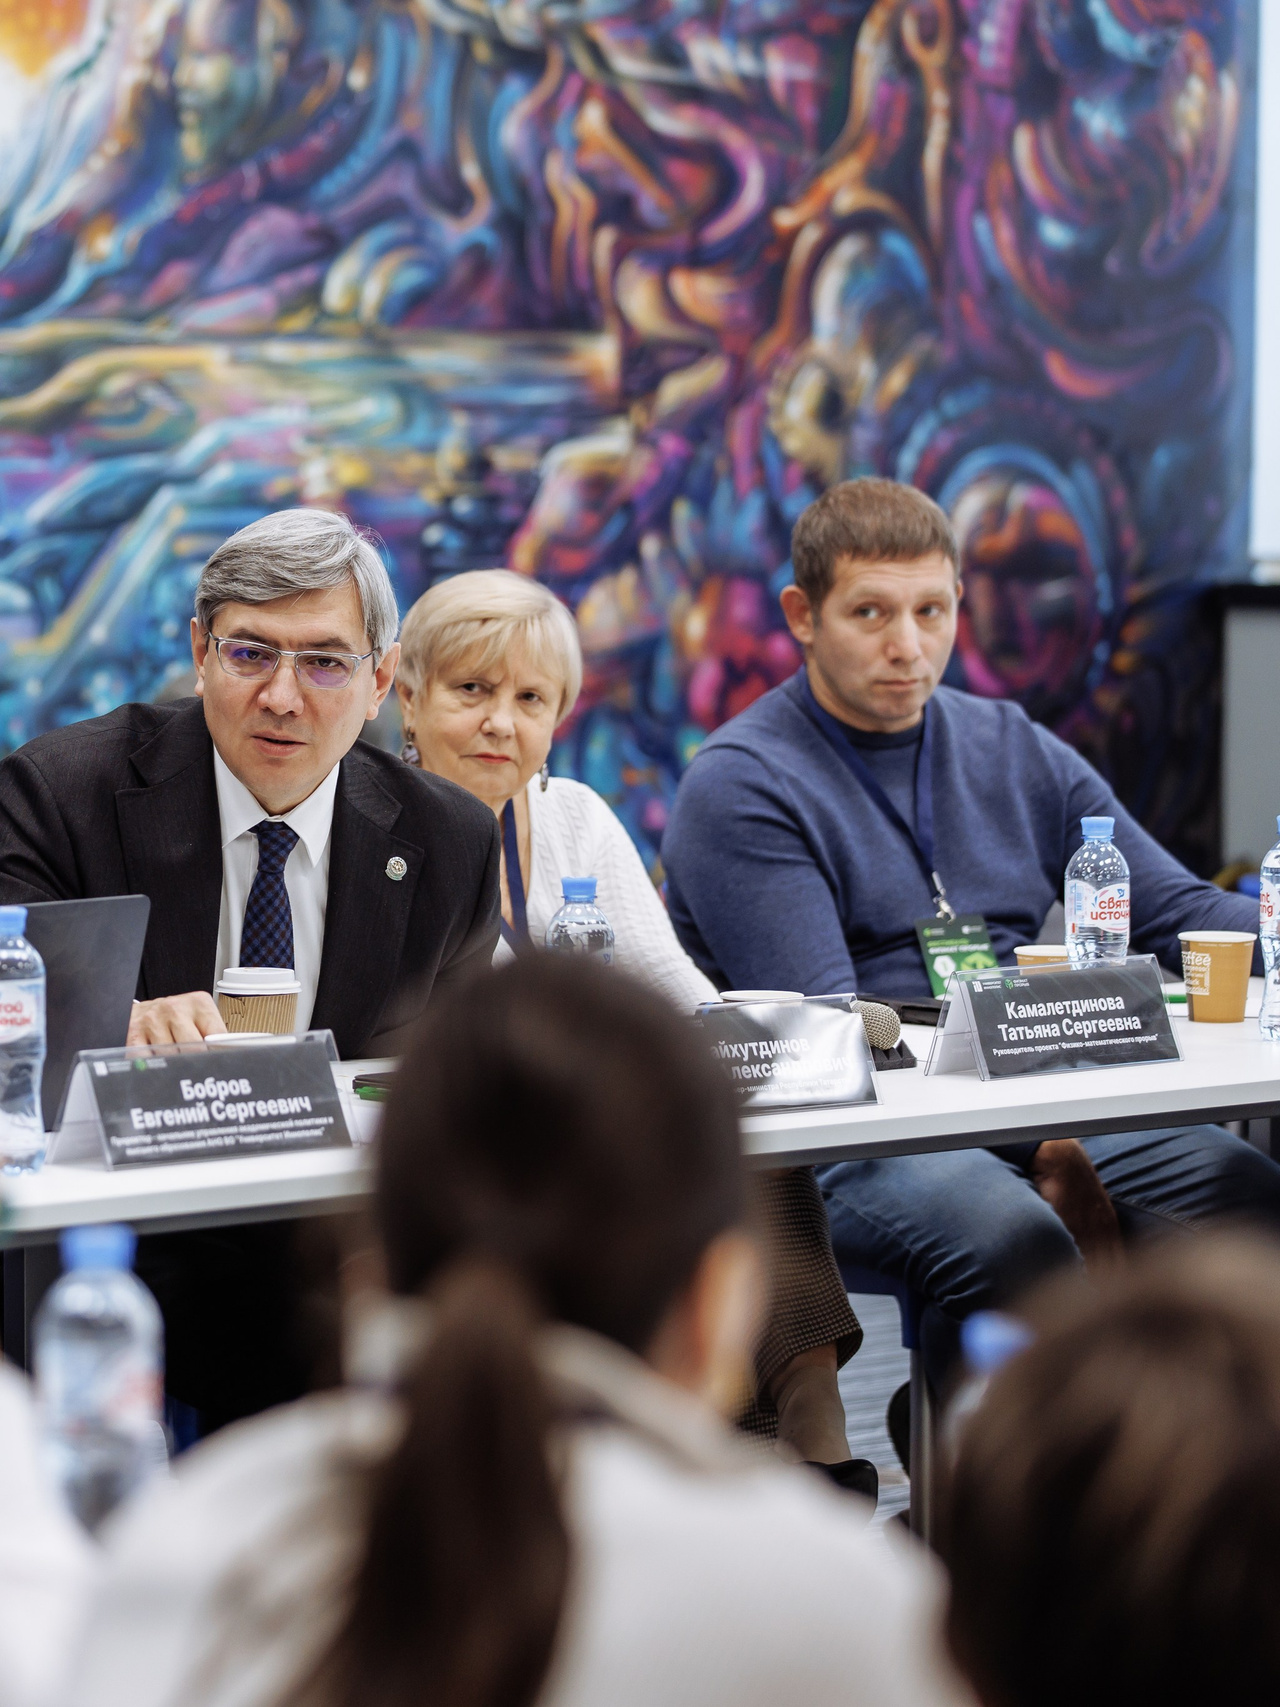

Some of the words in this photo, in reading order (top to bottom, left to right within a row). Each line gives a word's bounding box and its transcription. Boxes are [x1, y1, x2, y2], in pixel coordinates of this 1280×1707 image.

[1098, 896, 1130, 909] свято
[1090, 911, 1130, 920] источн
[1005, 995, 1125, 1020] Камалетдинова
[997, 1022, 1061, 1042] Татьяна
[1061, 1015, 1141, 1038] Сергеевна
[711, 1038, 810, 1061] айхутдинов
[992, 1047, 1034, 1057] Руководитель
[1035, 1044, 1059, 1053] проекта
[727, 1055, 851, 1080] лександрович
[180, 1077, 252, 1101] Бобров
[130, 1102, 210, 1130] Евгений
[210, 1096, 312, 1123] Сергеевич
